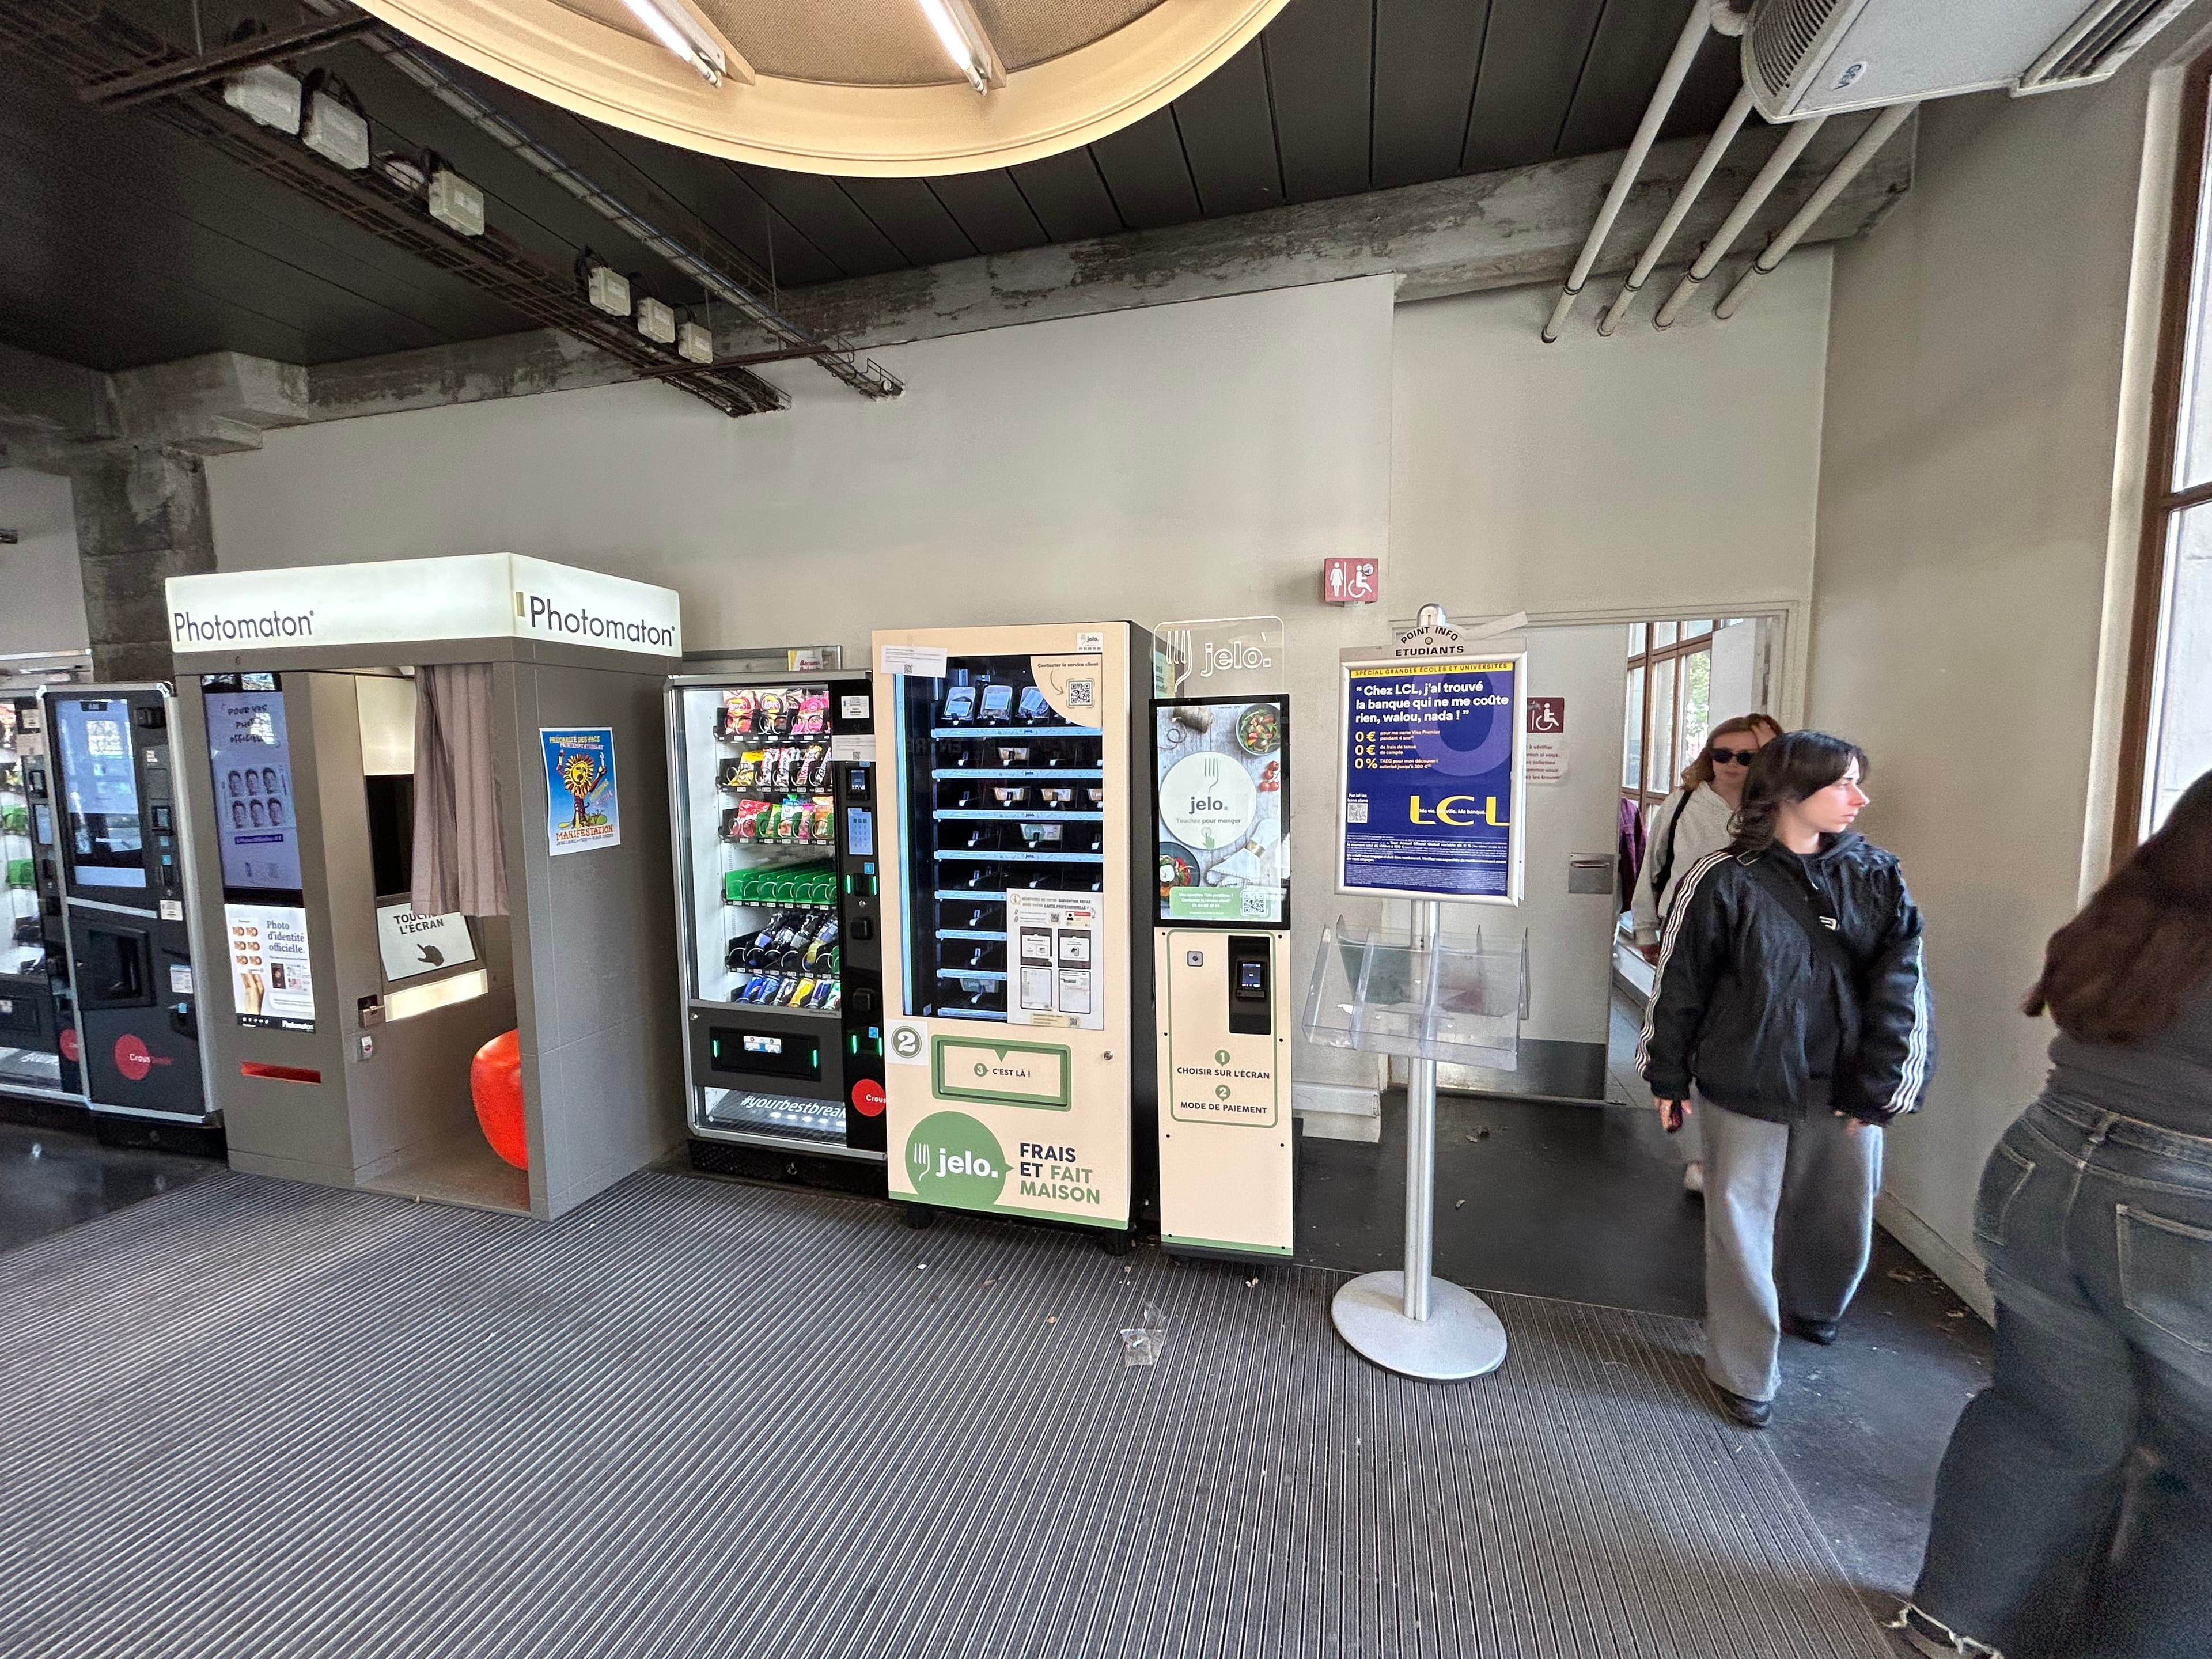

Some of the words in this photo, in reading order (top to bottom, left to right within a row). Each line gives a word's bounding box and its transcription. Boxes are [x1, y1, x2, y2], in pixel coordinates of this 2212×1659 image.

[174, 611, 312, 642] Photomaton
[530, 596, 672, 647] Photomaton
[1401, 626, 1430, 644] POINT
[1435, 627, 1458, 641] INFO
[1200, 641, 1271, 677] jelo.
[1396, 646, 1464, 657] ETUDIANTS
[1460, 662, 1508, 671] UNIVERSITÉS
[1363, 685, 1393, 696] Chez
[1395, 684, 1422, 696] LCL,
[1424, 683, 1441, 696] j'ai
[1443, 681, 1483, 693] trouvé
[1356, 699, 1365, 710] la
[1368, 698, 1410, 711] banque
[1412, 697, 1431, 710] qui
[1434, 698, 1449, 707] ne
[1451, 698, 1469, 706] me
[1472, 695, 1509, 706] coûte
[1355, 714, 1381, 725] rien,
[1382, 711, 1421, 723] walou,
[1424, 711, 1453, 722] nada
[1456, 710, 1460, 721] !
[1355, 731, 1365, 743] 0
[1366, 730, 1376, 742] €
[1355, 744, 1365, 756] 0
[1366, 744, 1376, 756] €
[1354, 757, 1364, 769] 0
[1366, 757, 1378, 769] %
[1188, 796, 1228, 815] jelo.
[1410, 795, 1509, 826] LCL
[555, 824, 613, 841] MANIFESTATION
[266, 920, 290, 930] Photo
[399, 918, 444, 935] L'ÉCRAN
[268, 931, 305, 942] d'identité
[269, 942, 305, 953] officielle.
[897, 1031, 916, 1052] 2
[129, 1053, 150, 1063] Crous
[1219, 1052, 1225, 1062] 1
[976, 1065, 984, 1075] 3
[992, 1068, 1013, 1076] C'EST
[1016, 1069, 1025, 1077] LÀ
[1177, 1067, 1212, 1076] CHOISIR
[1214, 1069, 1232, 1077] SUR
[1234, 1069, 1270, 1080] L'ÉCRAN
[866, 1094, 885, 1103] Crous
[1219, 1087, 1226, 1097] 2
[1181, 1101, 1206, 1111] MODE
[1209, 1103, 1221, 1111] DE
[1222, 1104, 1267, 1114] PAIEMENT
[1020, 1142, 1076, 1162] FRAIS
[935, 1147, 998, 1178] jelo.
[1020, 1161, 1043, 1178] ET
[1051, 1165, 1093, 1184] FAIT
[1020, 1180, 1100, 1204] MAISON
